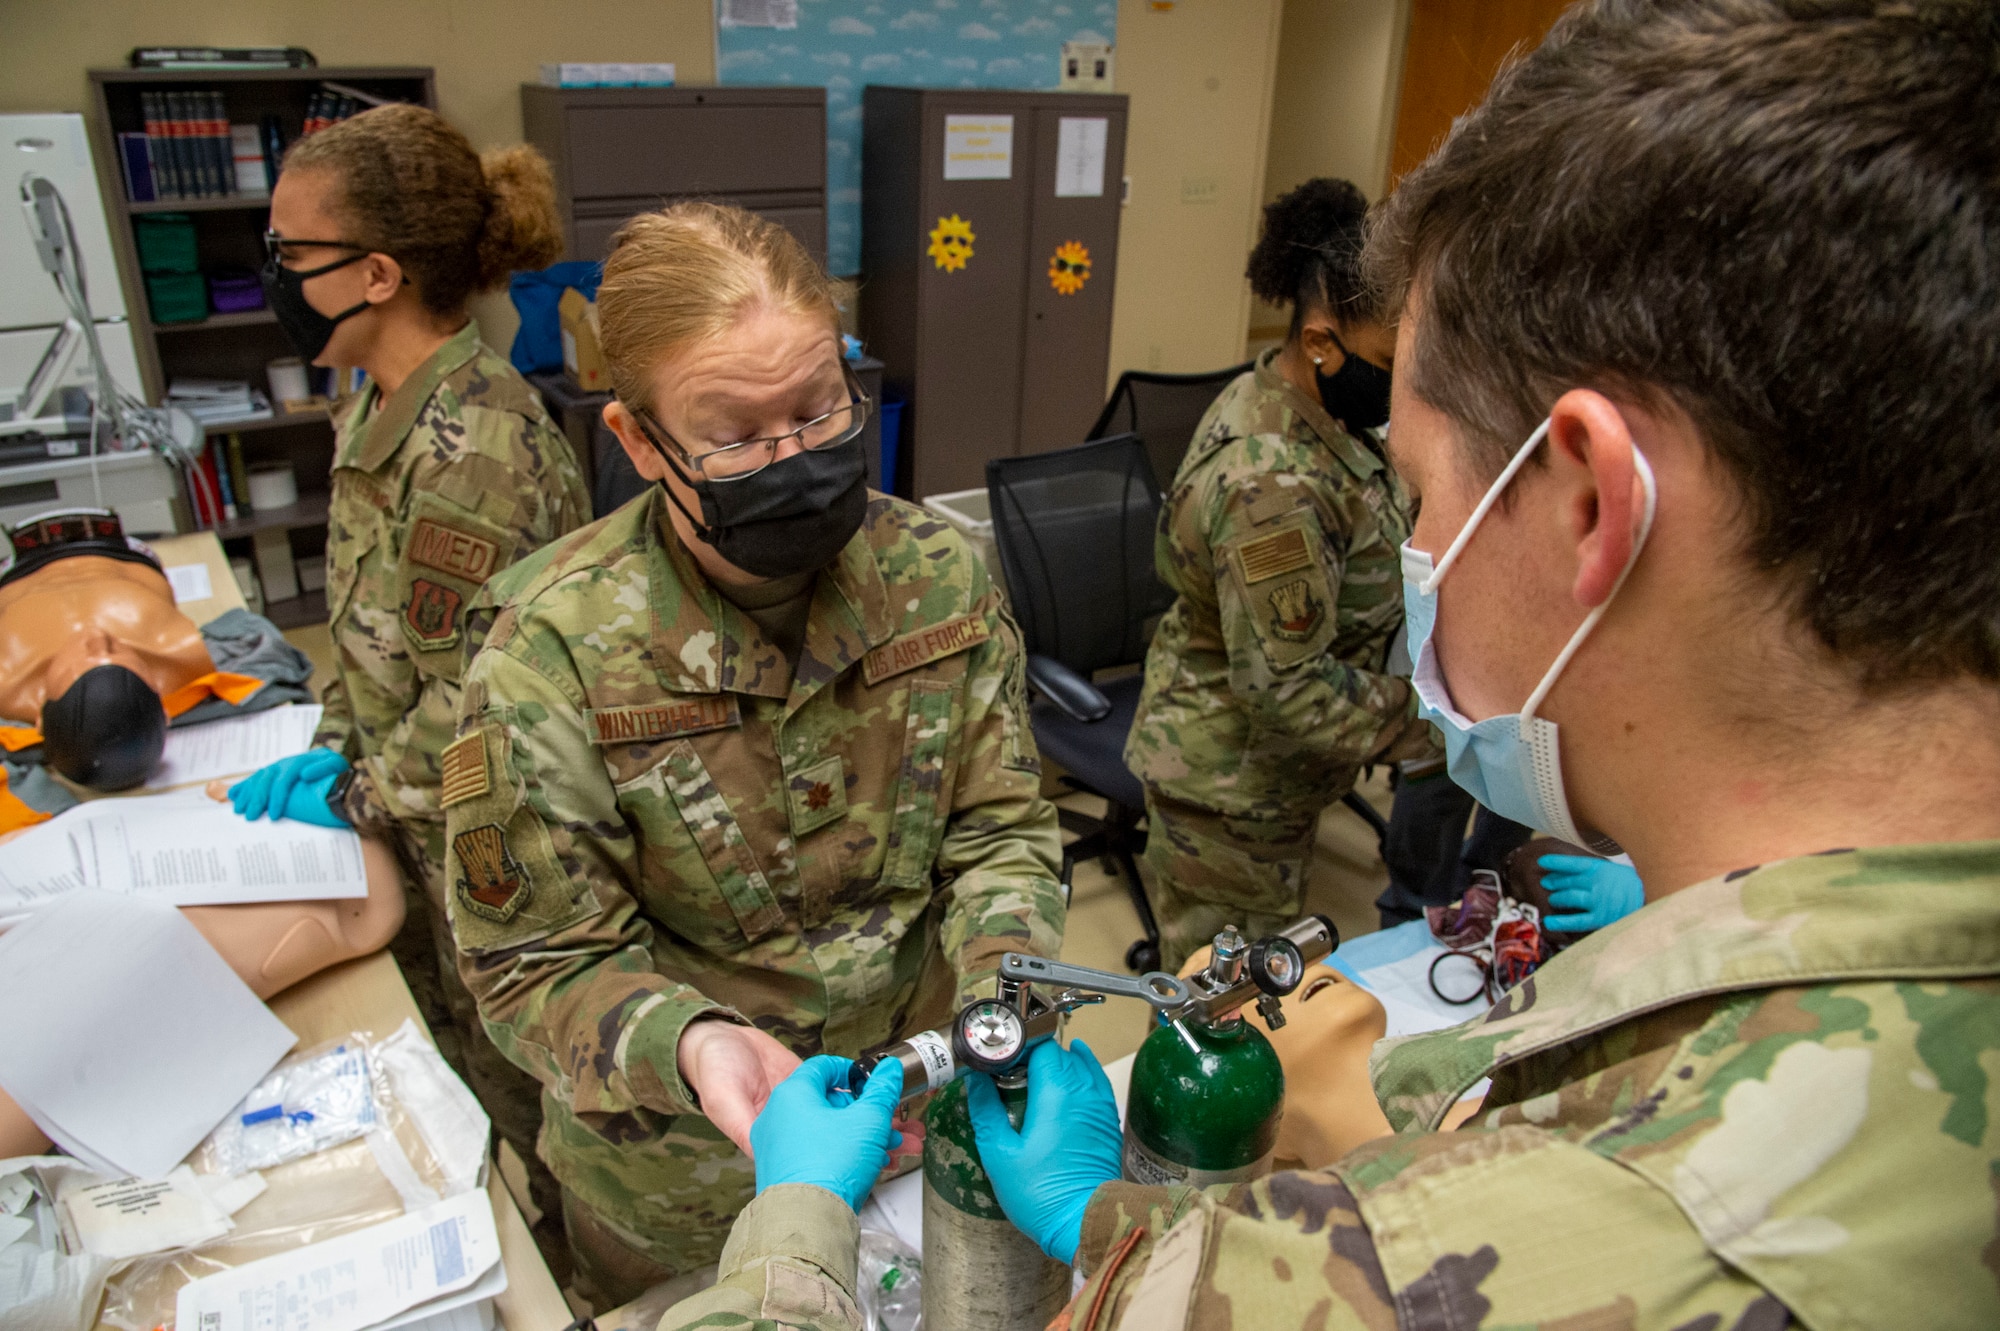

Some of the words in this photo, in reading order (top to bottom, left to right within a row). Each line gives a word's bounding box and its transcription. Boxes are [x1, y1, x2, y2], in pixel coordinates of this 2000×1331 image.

[414, 525, 487, 573] MED
[868, 649, 889, 677] US
[893, 639, 924, 669] AIR
[923, 616, 981, 656] FORCE
[595, 699, 729, 741] WINTERHELD
